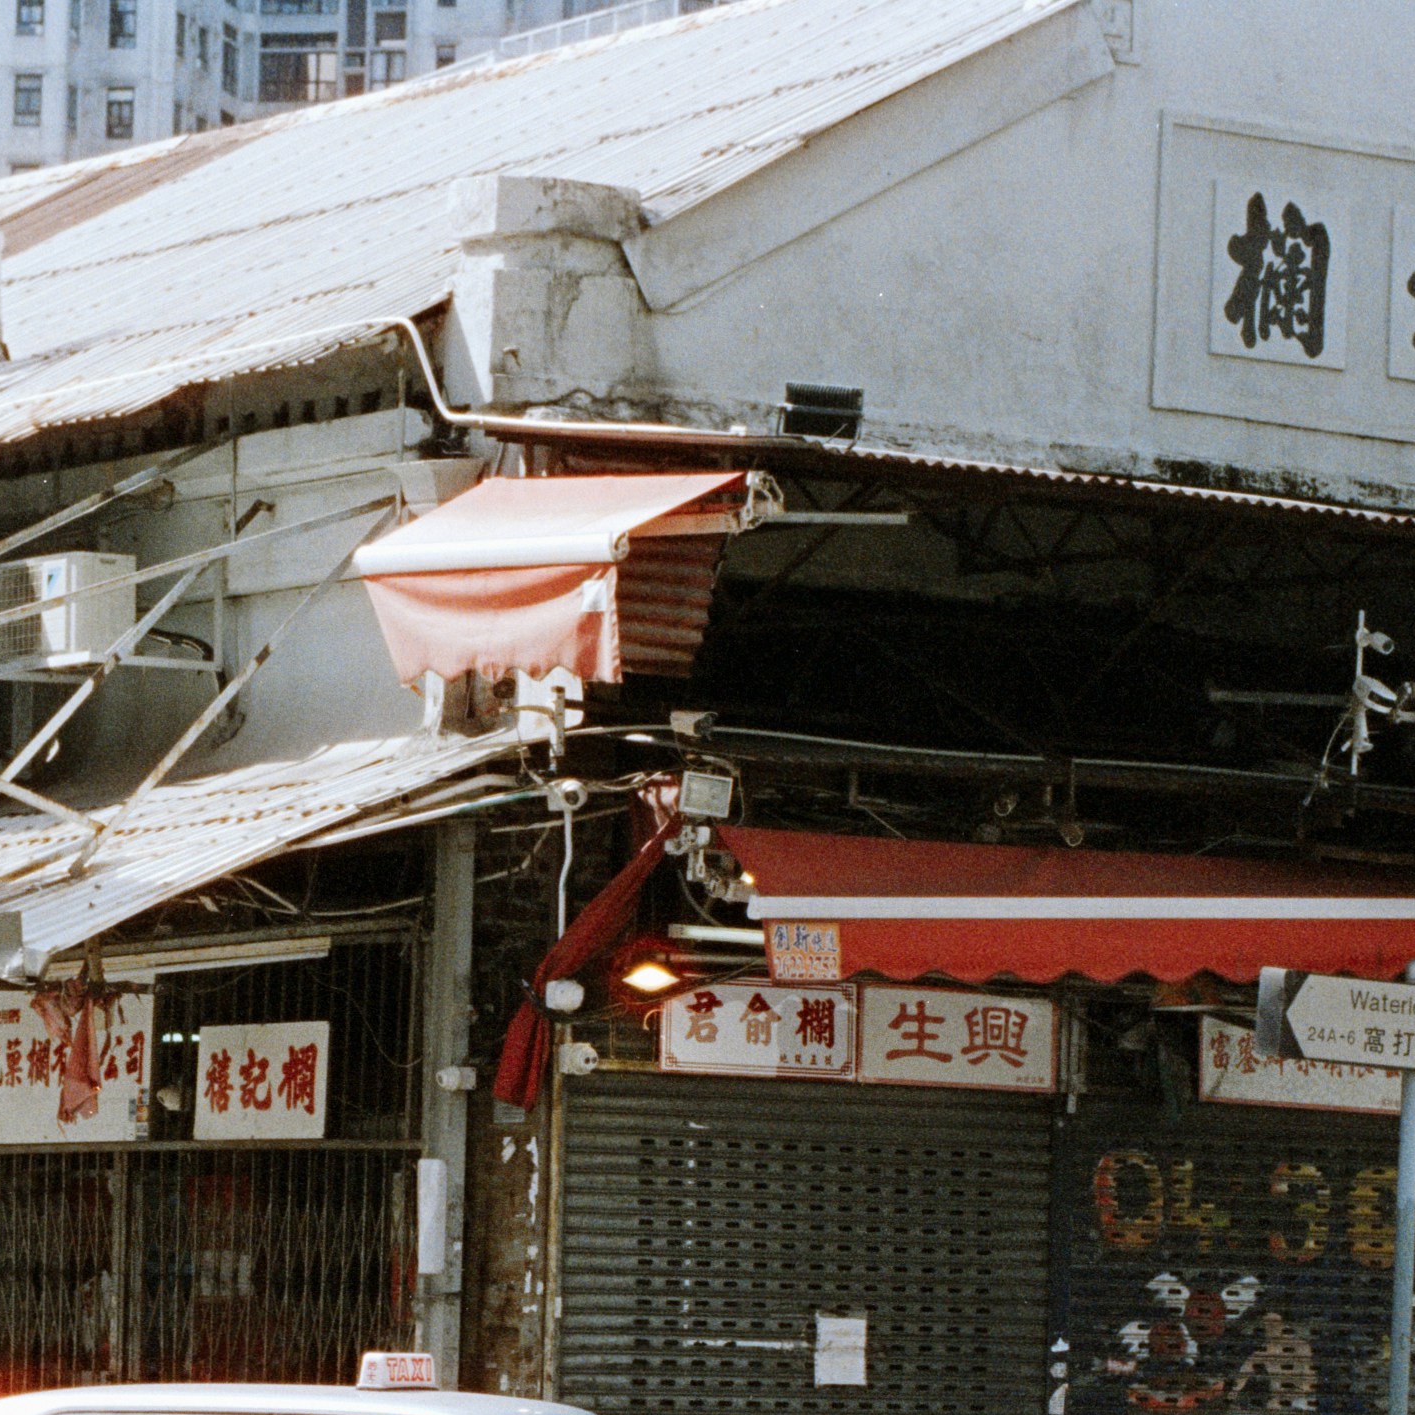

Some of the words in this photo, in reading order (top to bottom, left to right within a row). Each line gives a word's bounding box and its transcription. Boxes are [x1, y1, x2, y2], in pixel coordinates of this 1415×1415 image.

[886, 1001, 1028, 1068] 生興
[1307, 1027, 1355, 1046] 24A-6
[386, 1357, 433, 1382] TAXI
